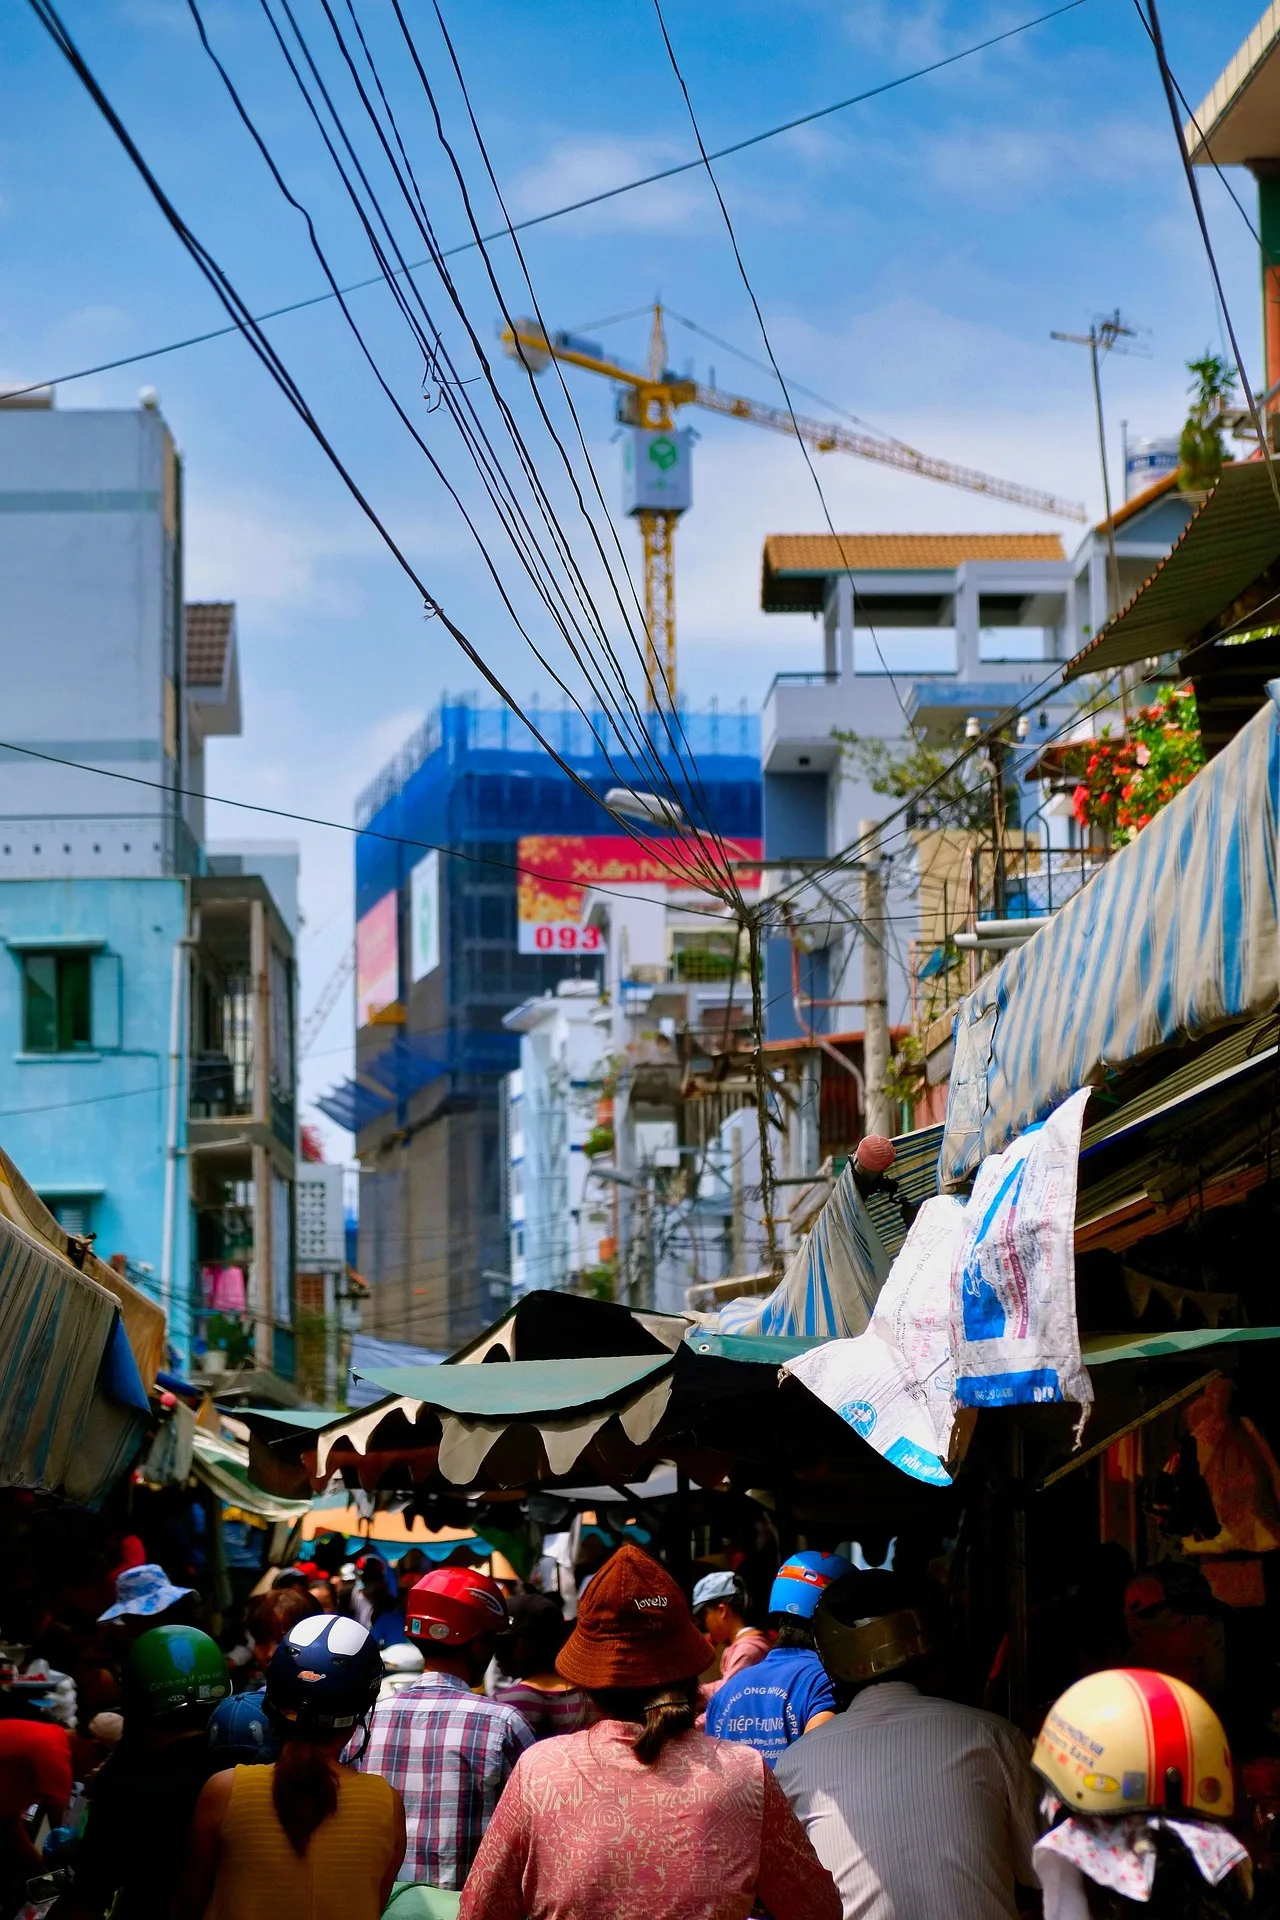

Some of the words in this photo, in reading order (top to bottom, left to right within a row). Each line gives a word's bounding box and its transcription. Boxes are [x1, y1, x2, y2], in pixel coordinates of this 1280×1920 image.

[571, 859, 638, 880] Xuân
[534, 925, 600, 949] 093
[634, 1595, 668, 1610] lovely
[196, 1672, 211, 1682] you
[728, 1715, 754, 1734] HIỆP
